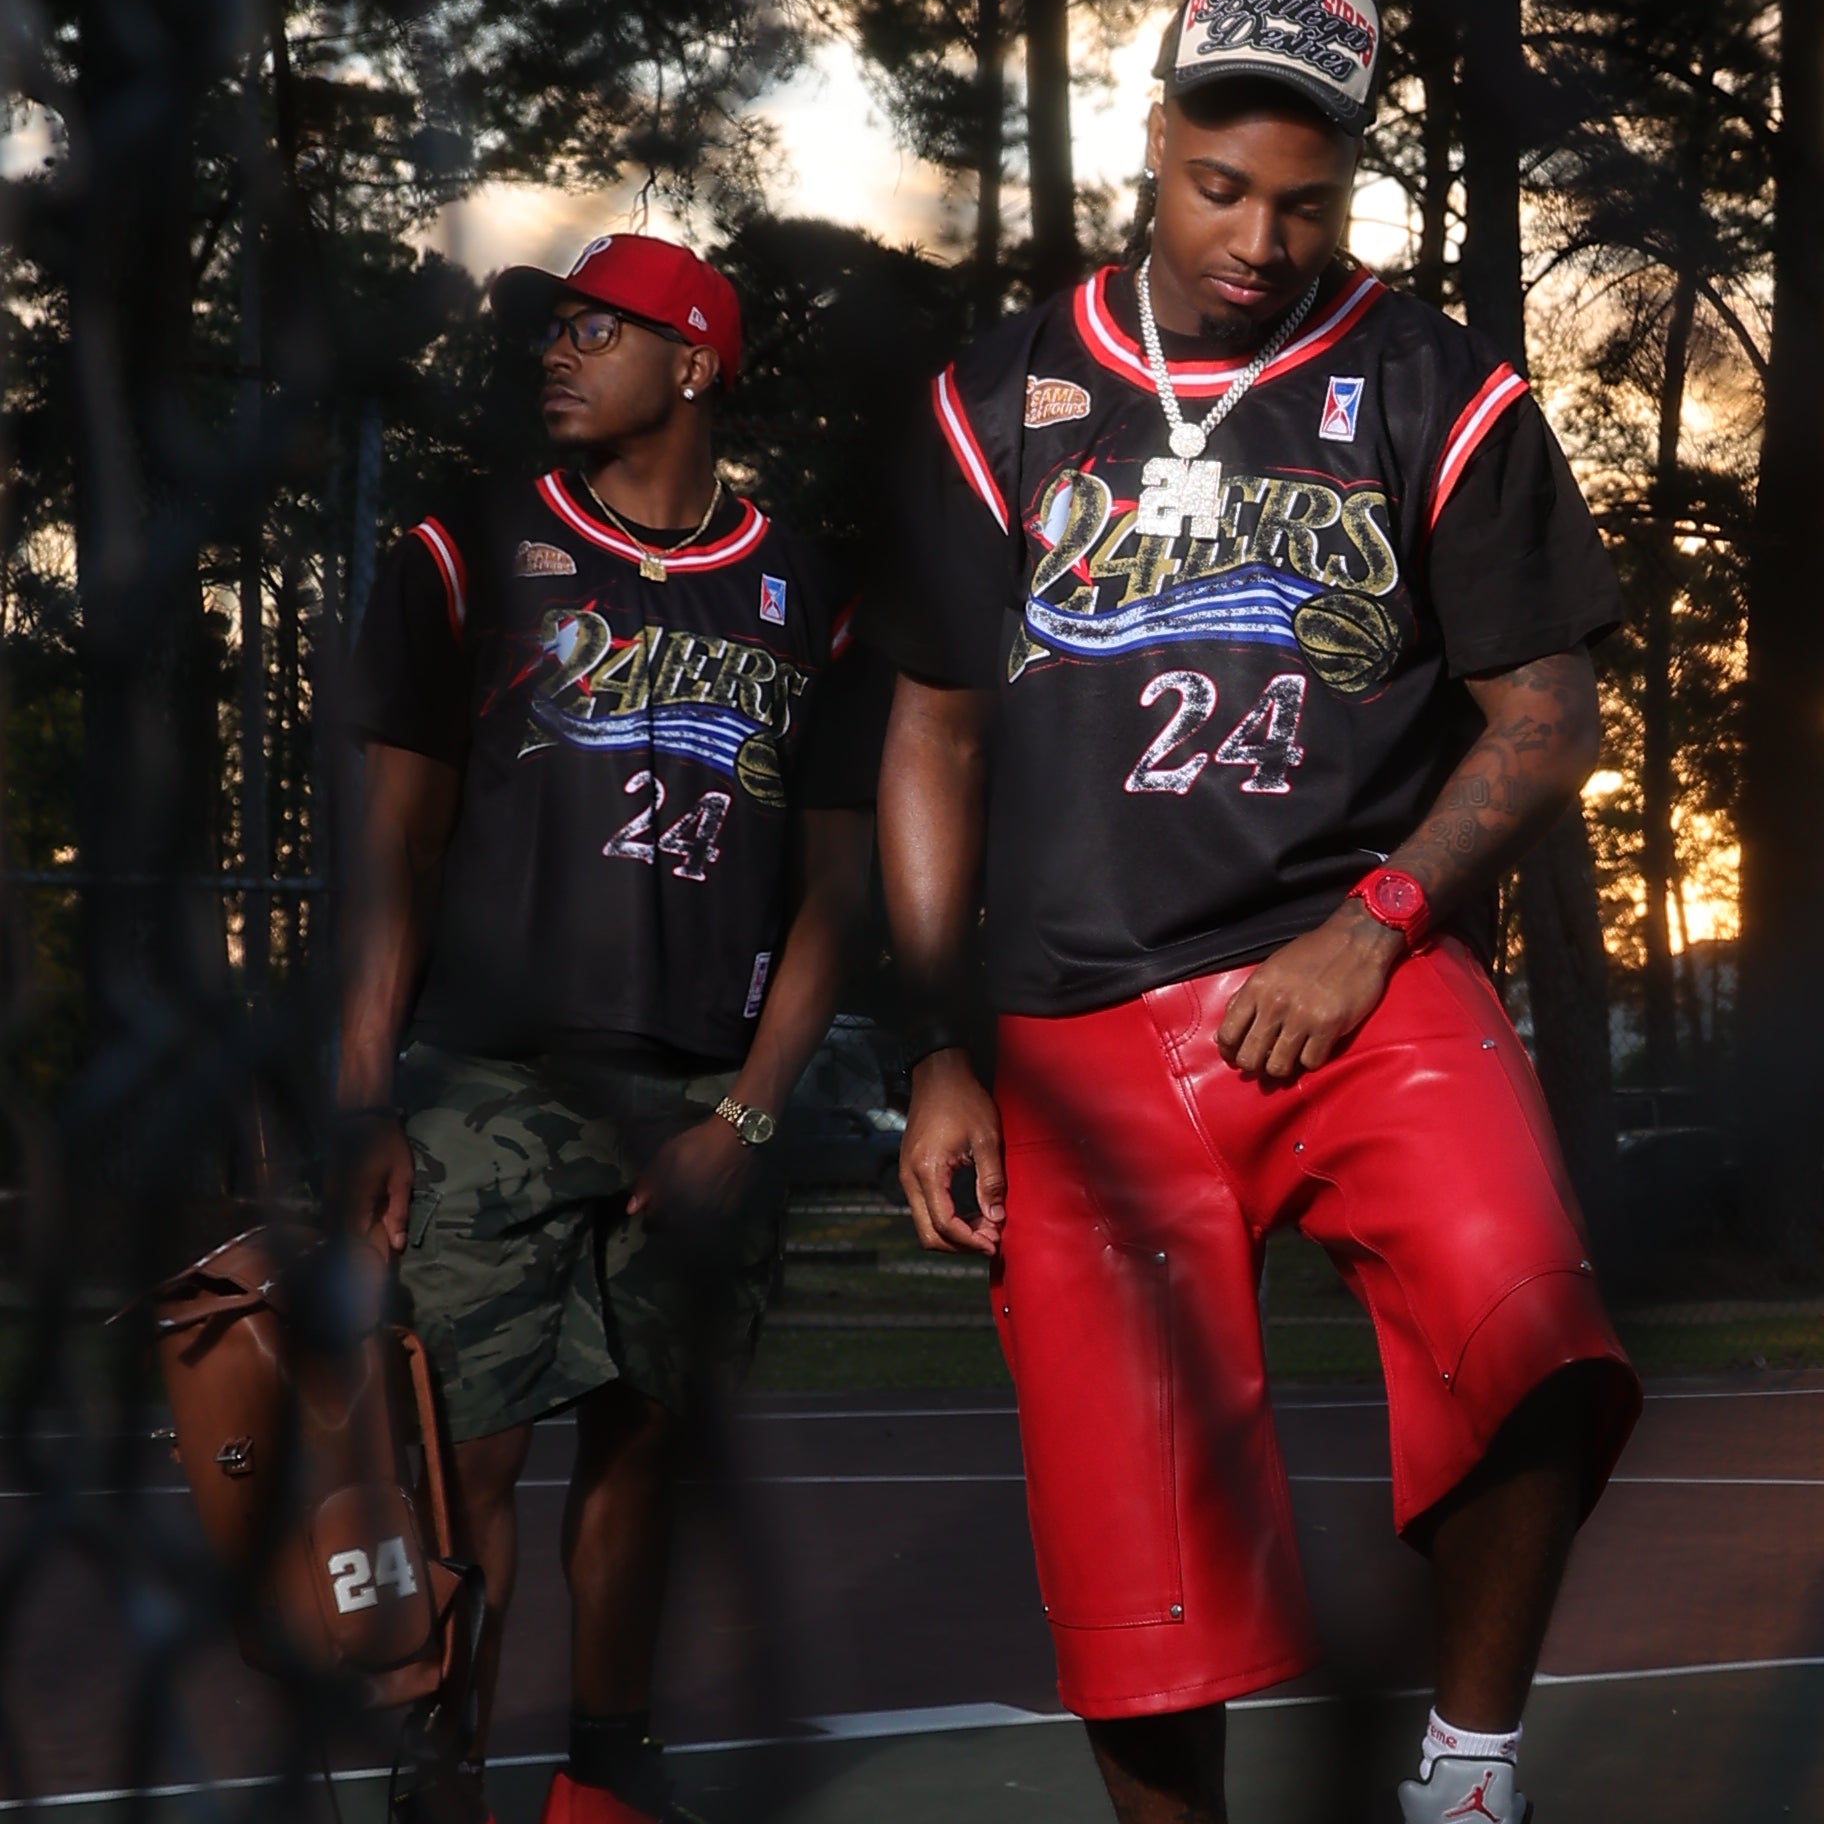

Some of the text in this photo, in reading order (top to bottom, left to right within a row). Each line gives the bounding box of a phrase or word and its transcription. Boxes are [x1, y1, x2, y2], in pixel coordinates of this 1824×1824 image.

[1136, 457, 1222, 539] 24
[1124, 670, 1307, 795] 24
[602, 769, 732, 882] 24
[328, 1536, 418, 1614] 24
